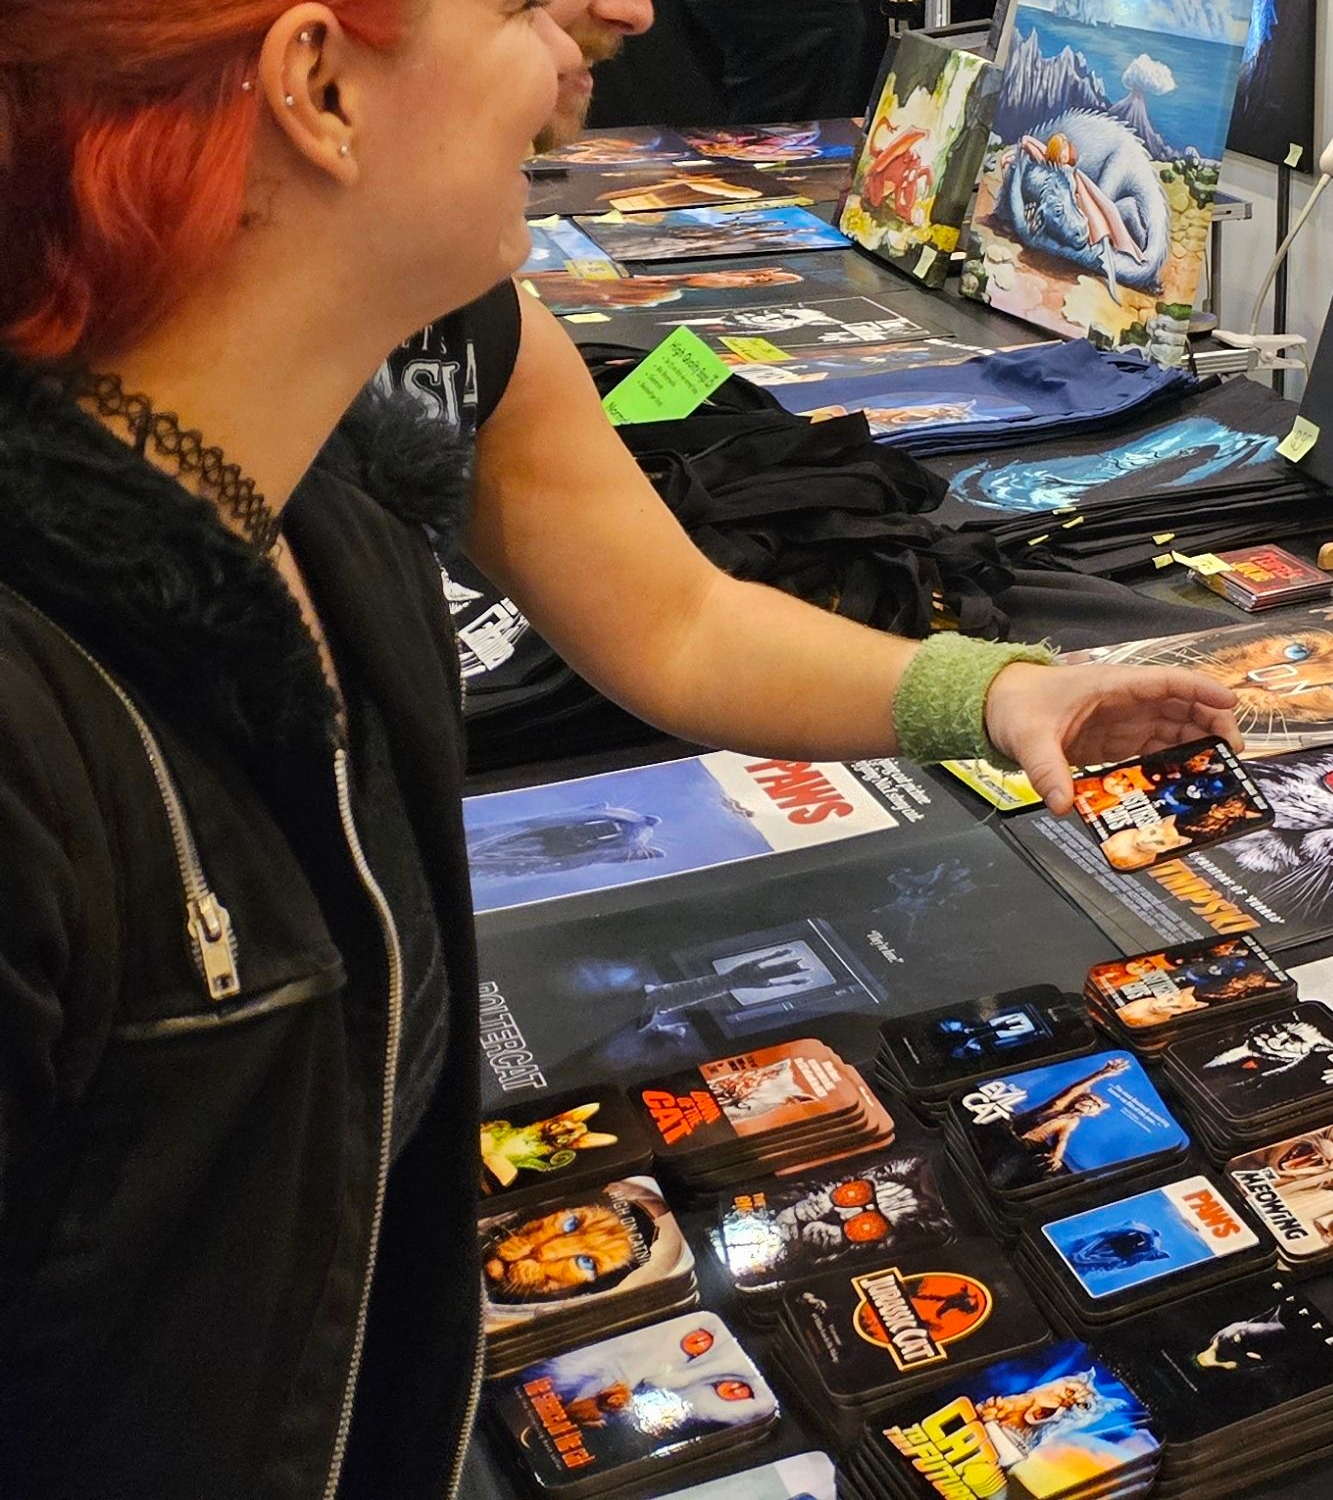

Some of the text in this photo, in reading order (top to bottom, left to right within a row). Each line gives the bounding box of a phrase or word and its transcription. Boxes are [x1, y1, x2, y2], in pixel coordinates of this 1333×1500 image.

[1248, 664, 1321, 697] ON
[642, 1091, 691, 1144] CAT
[962, 1092, 1013, 1124] CAT
[609, 1188, 630, 1212] HIGH
[1183, 1189, 1241, 1238] PAWS
[860, 1275, 935, 1362] JURASSIC CAT
[921, 1396, 1000, 1477] CAT
